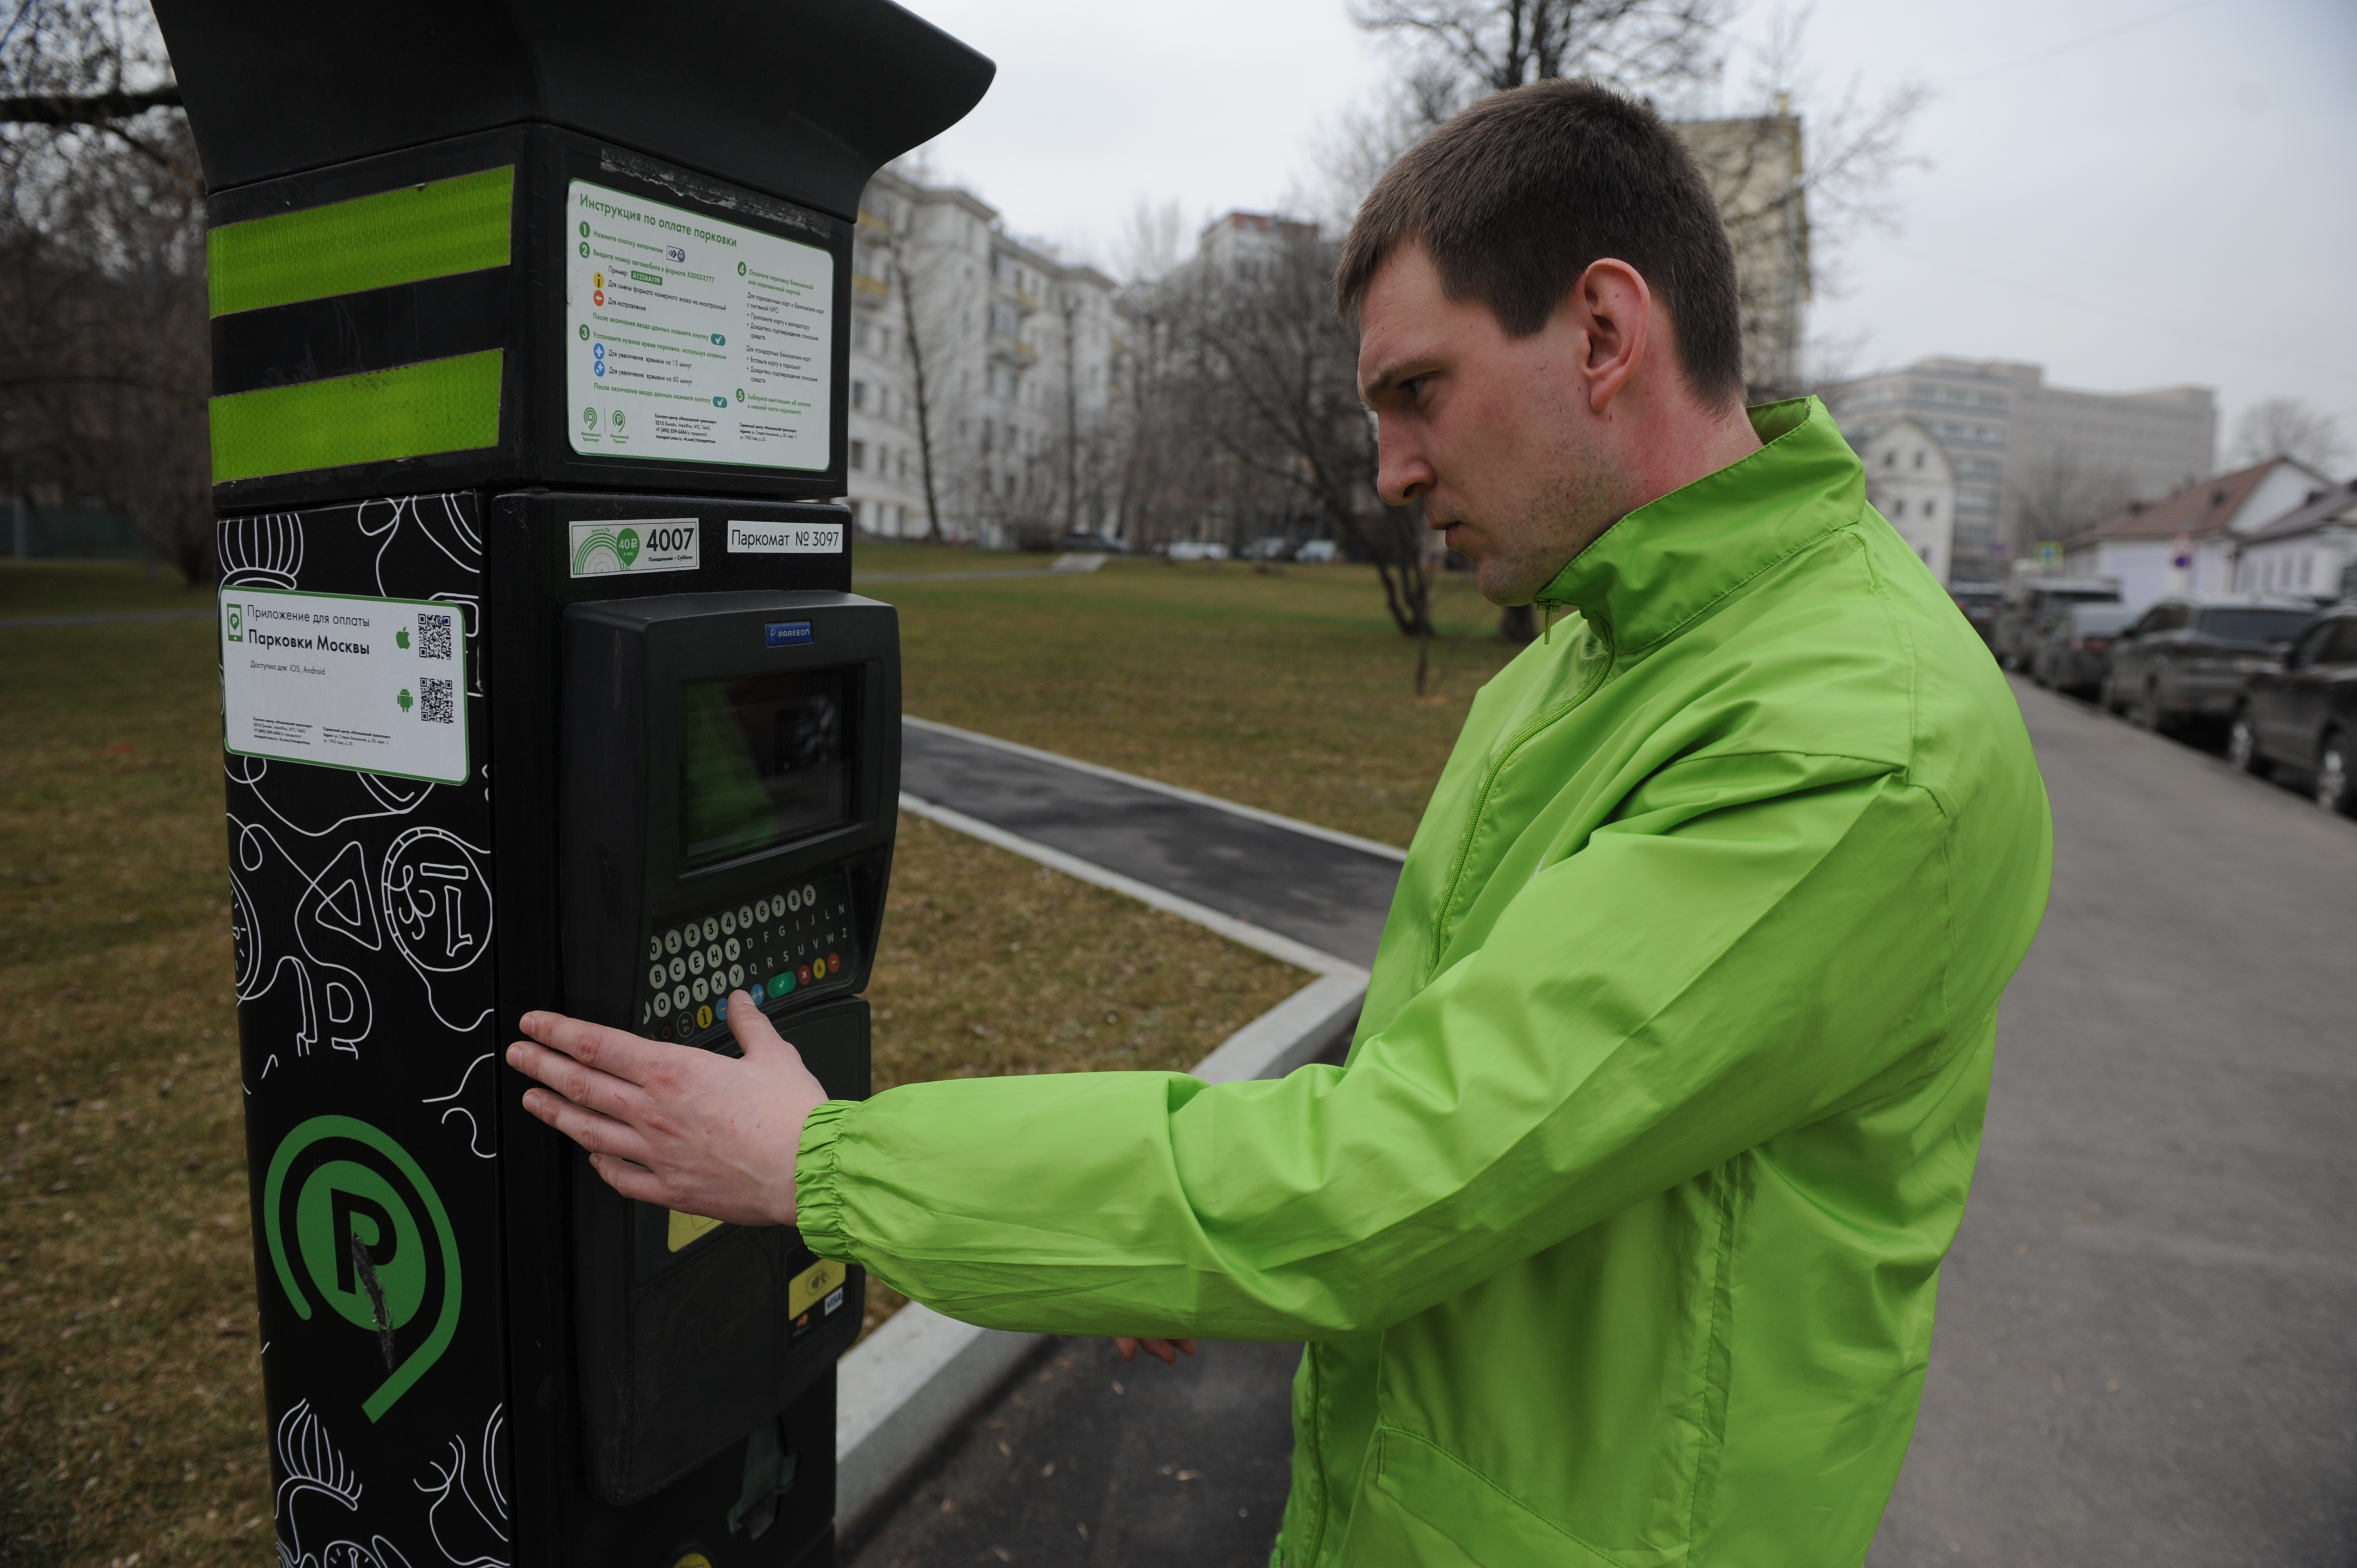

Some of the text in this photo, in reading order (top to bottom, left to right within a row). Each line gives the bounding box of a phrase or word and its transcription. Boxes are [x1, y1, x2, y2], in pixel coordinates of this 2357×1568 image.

[580, 193, 737, 247] Инструкция по оплате парковки
[583, 224, 663, 253] 1 Нажмите кнопку включения
[581, 244, 587, 256] 2
[593, 249, 614, 260] Введите
[615, 256, 630, 265] номер
[631, 260, 660, 271] автомобиля
[665, 266, 686, 277] формате
[608, 265, 627, 277] Пример:
[739, 264, 744, 275] 4
[608, 297, 646, 311] Для исправления
[633, 286, 653, 296] формата
[654, 292, 678, 301] номерного
[699, 301, 726, 311] иностранный
[593, 312, 608, 321] После
[609, 317, 635, 326] окончания
[692, 333, 709, 341] кнопку
[581, 327, 587, 338] 3
[593, 331, 621, 342] Установите
[656, 344, 681, 353] парковки,
[682, 349, 706, 357] используя
[594, 382, 609, 390] После
[738, 391, 743, 400] 5
[646, 528, 694, 551] 4007
[732, 529, 790, 549] Паркомат
[812, 532, 838, 546] 3097
[247, 604, 369, 627] Приложение для оплаты
[249, 628, 369, 654] Парковки Москвы
[777, 627, 810, 637] PARKEON
[250, 660, 276, 670] Доступно
[289, 664, 301, 673] iOS,
[303, 666, 325, 675] Android
[670, 936, 677, 948] 1
[689, 929, 696, 941] 2
[708, 922, 714, 935] 3
[725, 917, 732, 928] 4
[743, 911, 749, 922] 5
[759, 905, 765, 917] 6
[775, 900, 780, 911] 7
[791, 895, 797, 906] 8
[806, 890, 812, 901] 9
[654, 904, 845, 983] B C E H K D F G I J L N
[678, 991, 685, 1003] P
[696, 983, 703, 996] T
[750, 963, 758, 975] Q
[767, 957, 773, 968] R
[783, 951, 789, 962] S
[798, 945, 804, 955] U
[812, 939, 819, 949] V
[826, 933, 833, 943] W
[842, 927, 847, 938] Z
[330, 1188, 398, 1296] P
[827, 1292, 841, 1308] VISA
